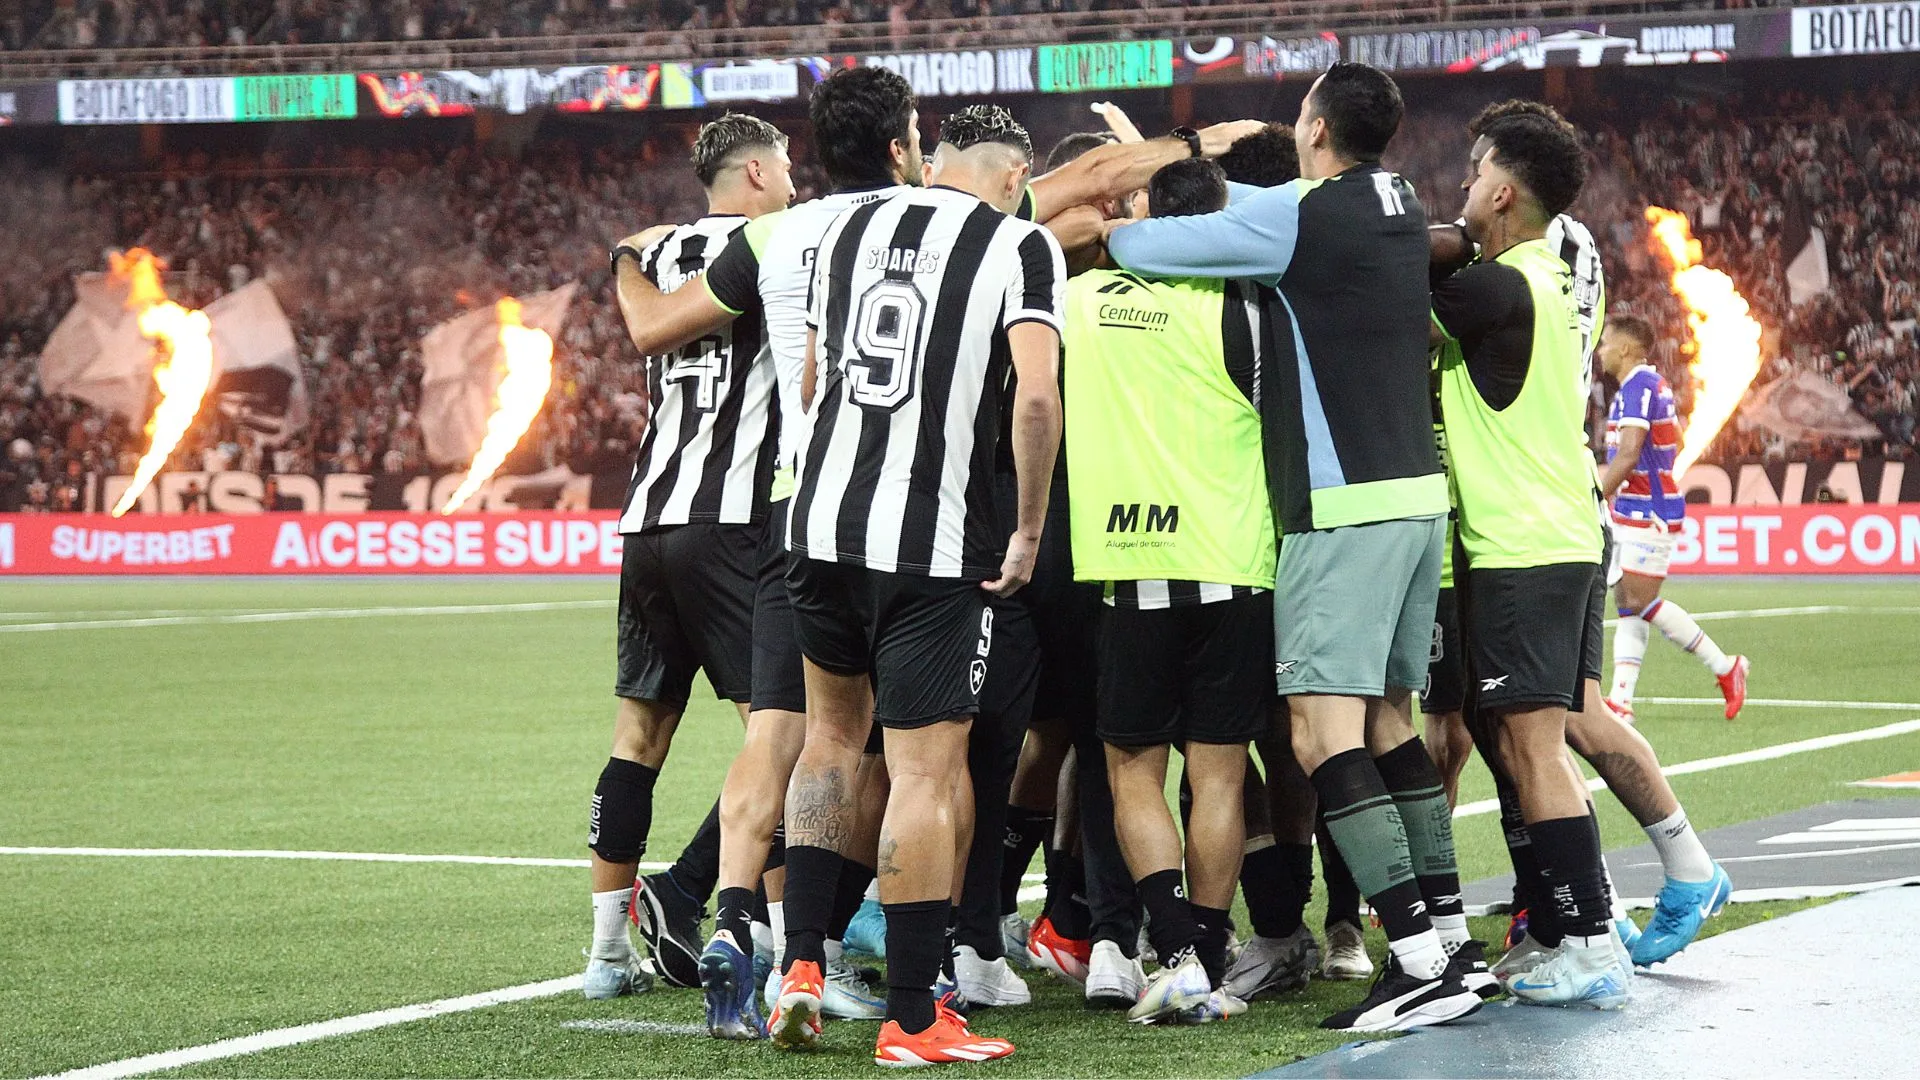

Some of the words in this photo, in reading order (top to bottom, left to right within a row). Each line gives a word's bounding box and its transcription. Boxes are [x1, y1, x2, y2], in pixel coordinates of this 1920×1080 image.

[1810, 6, 1920, 51] BOTAFO
[866, 50, 995, 98] TAFOGO
[997, 48, 1035, 92] INK
[1051, 45, 1128, 86] COMPRE
[73, 79, 189, 118] BOTAFOGO
[865, 246, 940, 274] SOARES
[1099, 304, 1168, 325] Centrum
[847, 279, 926, 414] 9
[50, 524, 234, 564] SUPERBET
[976, 606, 994, 657] 9
